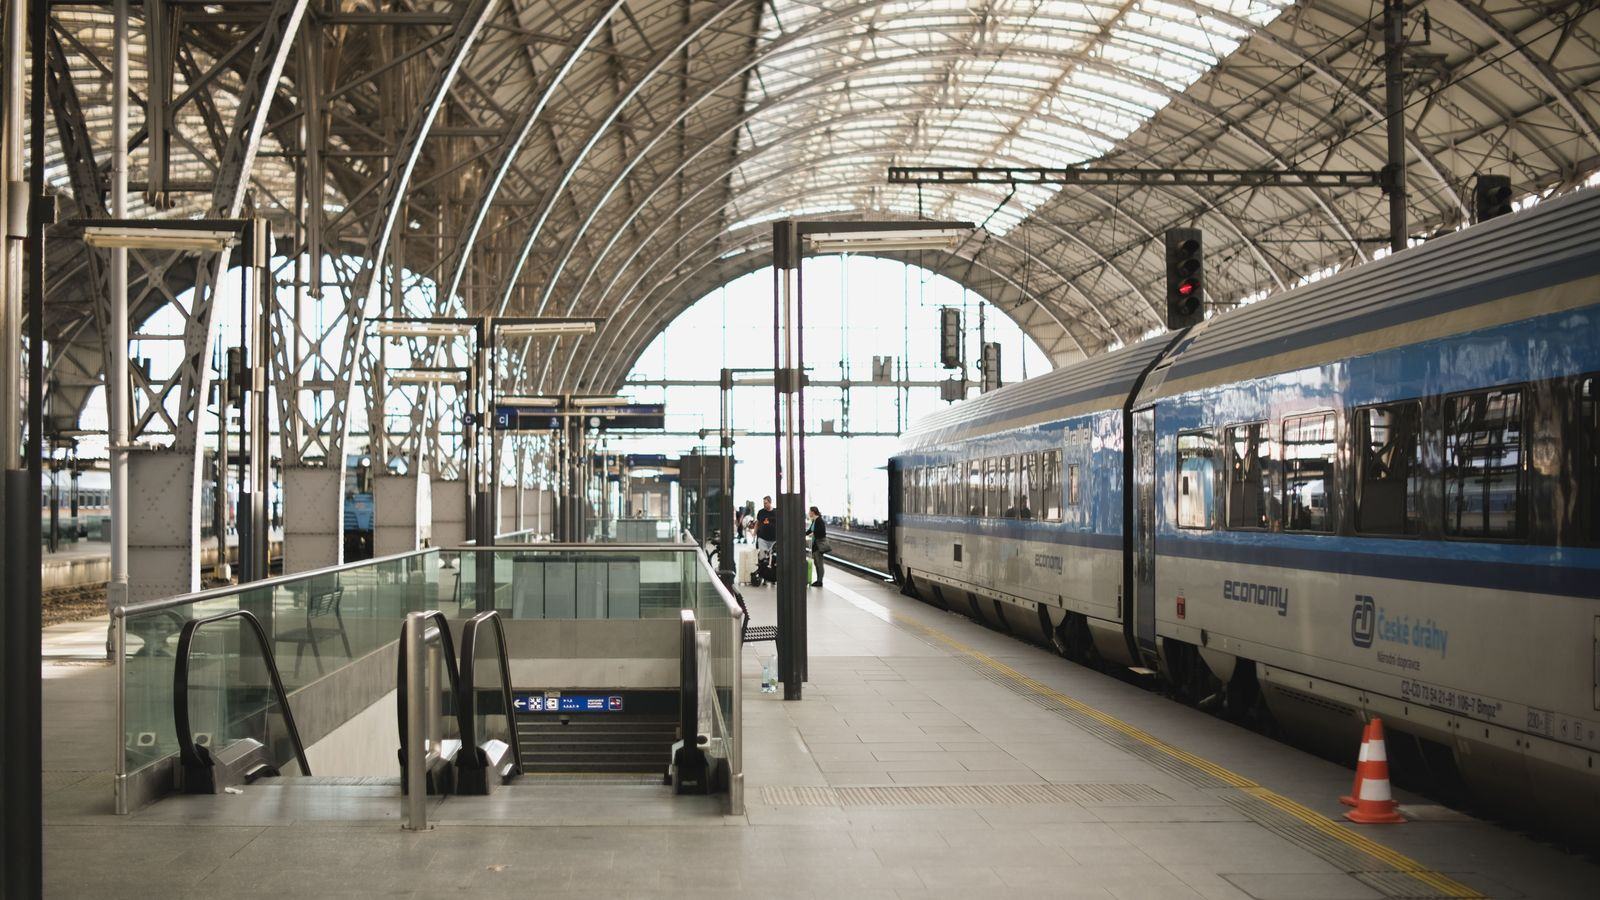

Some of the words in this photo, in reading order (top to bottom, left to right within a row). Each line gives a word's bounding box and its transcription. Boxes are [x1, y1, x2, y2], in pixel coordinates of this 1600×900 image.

[1223, 580, 1288, 616] economy
[1377, 606, 1409, 646] České
[1412, 617, 1448, 659] dráhy
